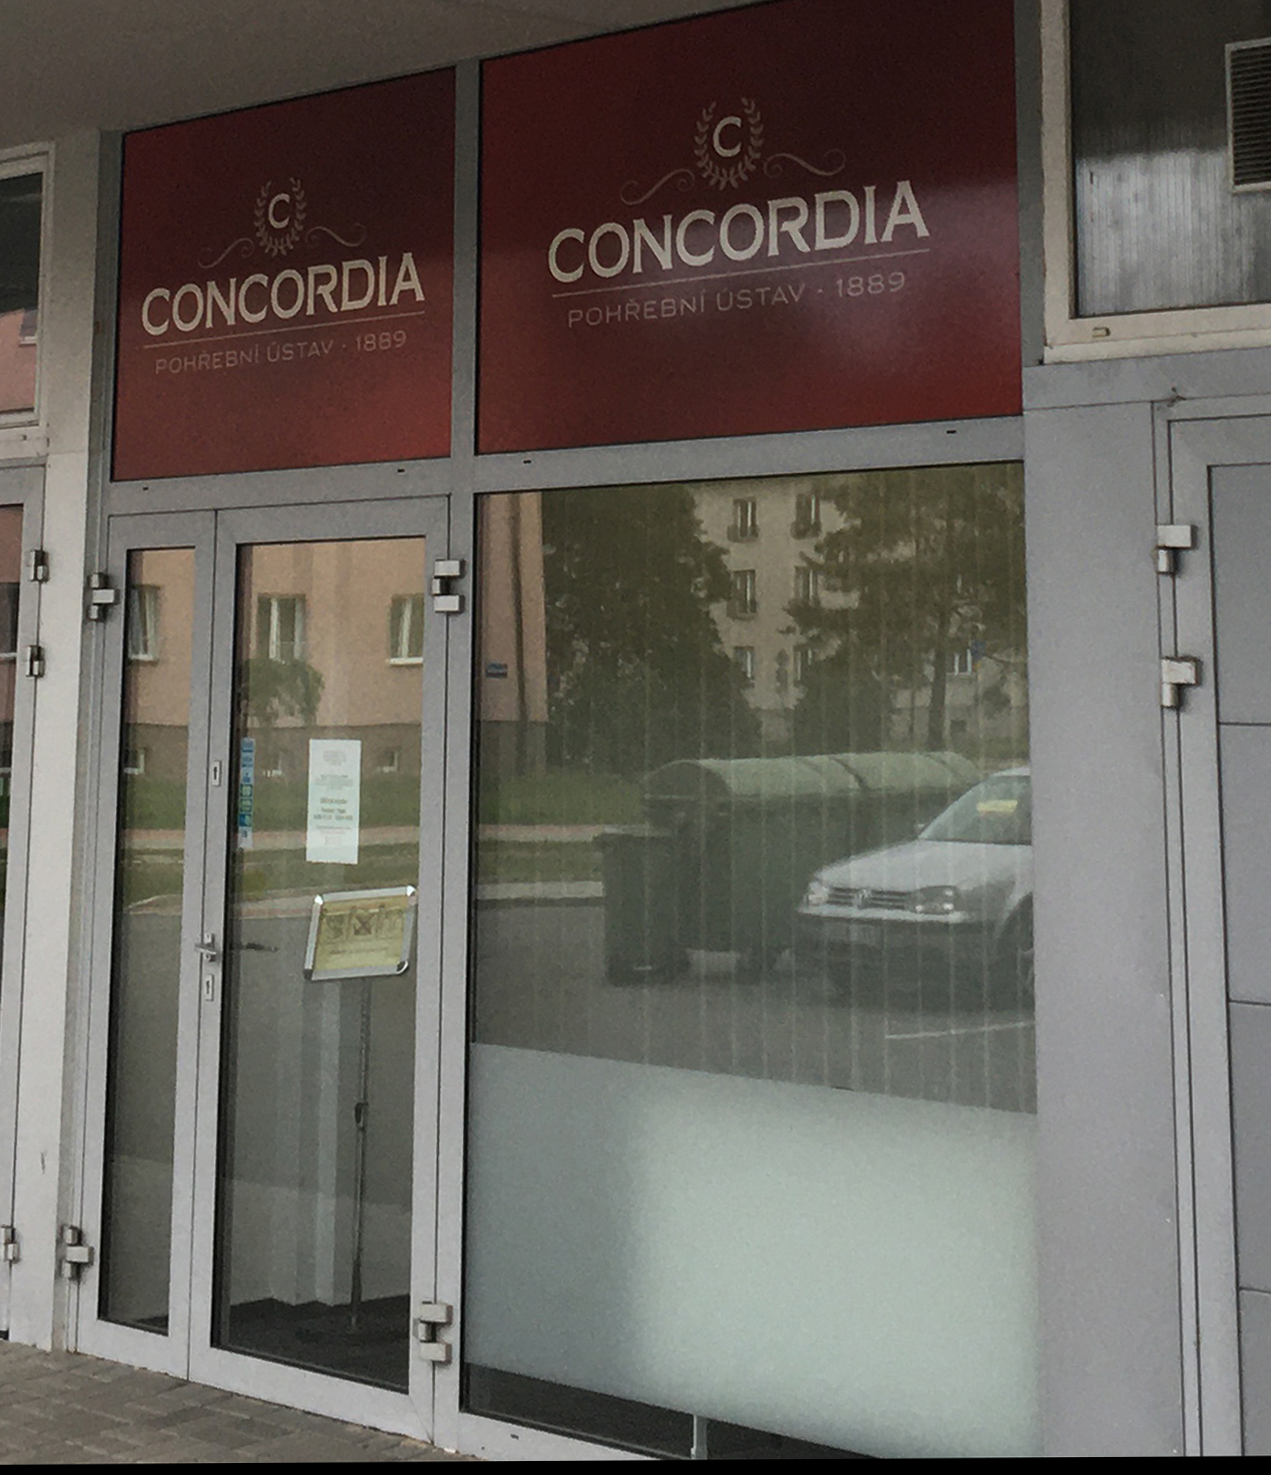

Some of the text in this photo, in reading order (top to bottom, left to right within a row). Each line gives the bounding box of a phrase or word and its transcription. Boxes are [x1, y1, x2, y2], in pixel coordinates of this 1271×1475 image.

[713, 116, 742, 158] C
[268, 193, 291, 228] C
[548, 180, 930, 283] CONCORDIA
[141, 252, 426, 336] CONCORDIA
[568, 271, 906, 329] POHŘEBNÍ ÚSTAV 1889
[155, 329, 407, 375] POHŘEBNÍ ÚSTAV 1889
